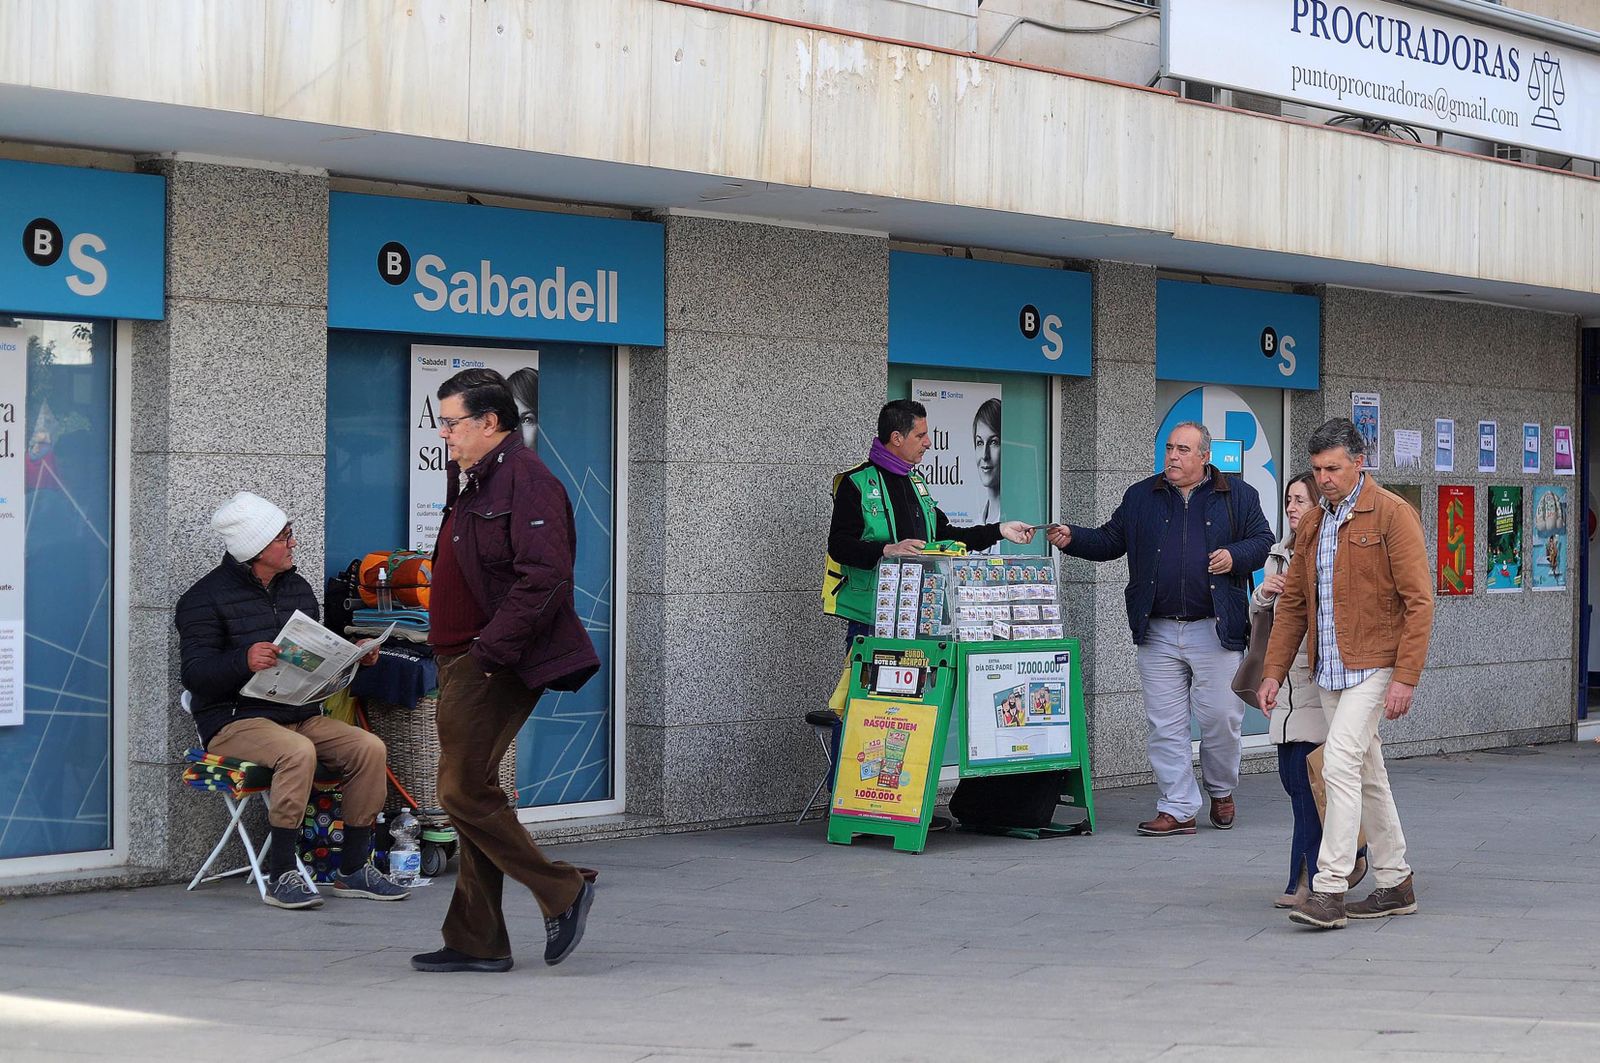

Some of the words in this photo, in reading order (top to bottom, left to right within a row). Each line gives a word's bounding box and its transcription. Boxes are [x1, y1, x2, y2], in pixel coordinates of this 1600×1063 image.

[1290, 0, 1520, 82] PROCURADORAS
[1292, 64, 1519, 127] puntoprocuradoras@gmail.com
[33, 228, 53, 256] B
[65, 233, 107, 296] S
[387, 251, 402, 276] B
[413, 254, 618, 324] Sabadell
[1024, 312, 1035, 332] B
[1041, 314, 1063, 361] S
[422, 357, 447, 366] Sabadell
[1265, 333, 1274, 351] B
[1278, 335, 1297, 377] S
[933, 426, 949, 451] tu
[418, 438, 448, 471] sal
[918, 456, 963, 485] salud.
[895, 671, 913, 685] 10
[976, 663, 984, 671] DÍA
[996, 663, 1013, 671] PADRE
[863, 718, 896, 730] RASQUE
[897, 720, 917, 732] DIEM
[855, 789, 895, 801] 1.000.000
[896, 794, 903, 802] €
